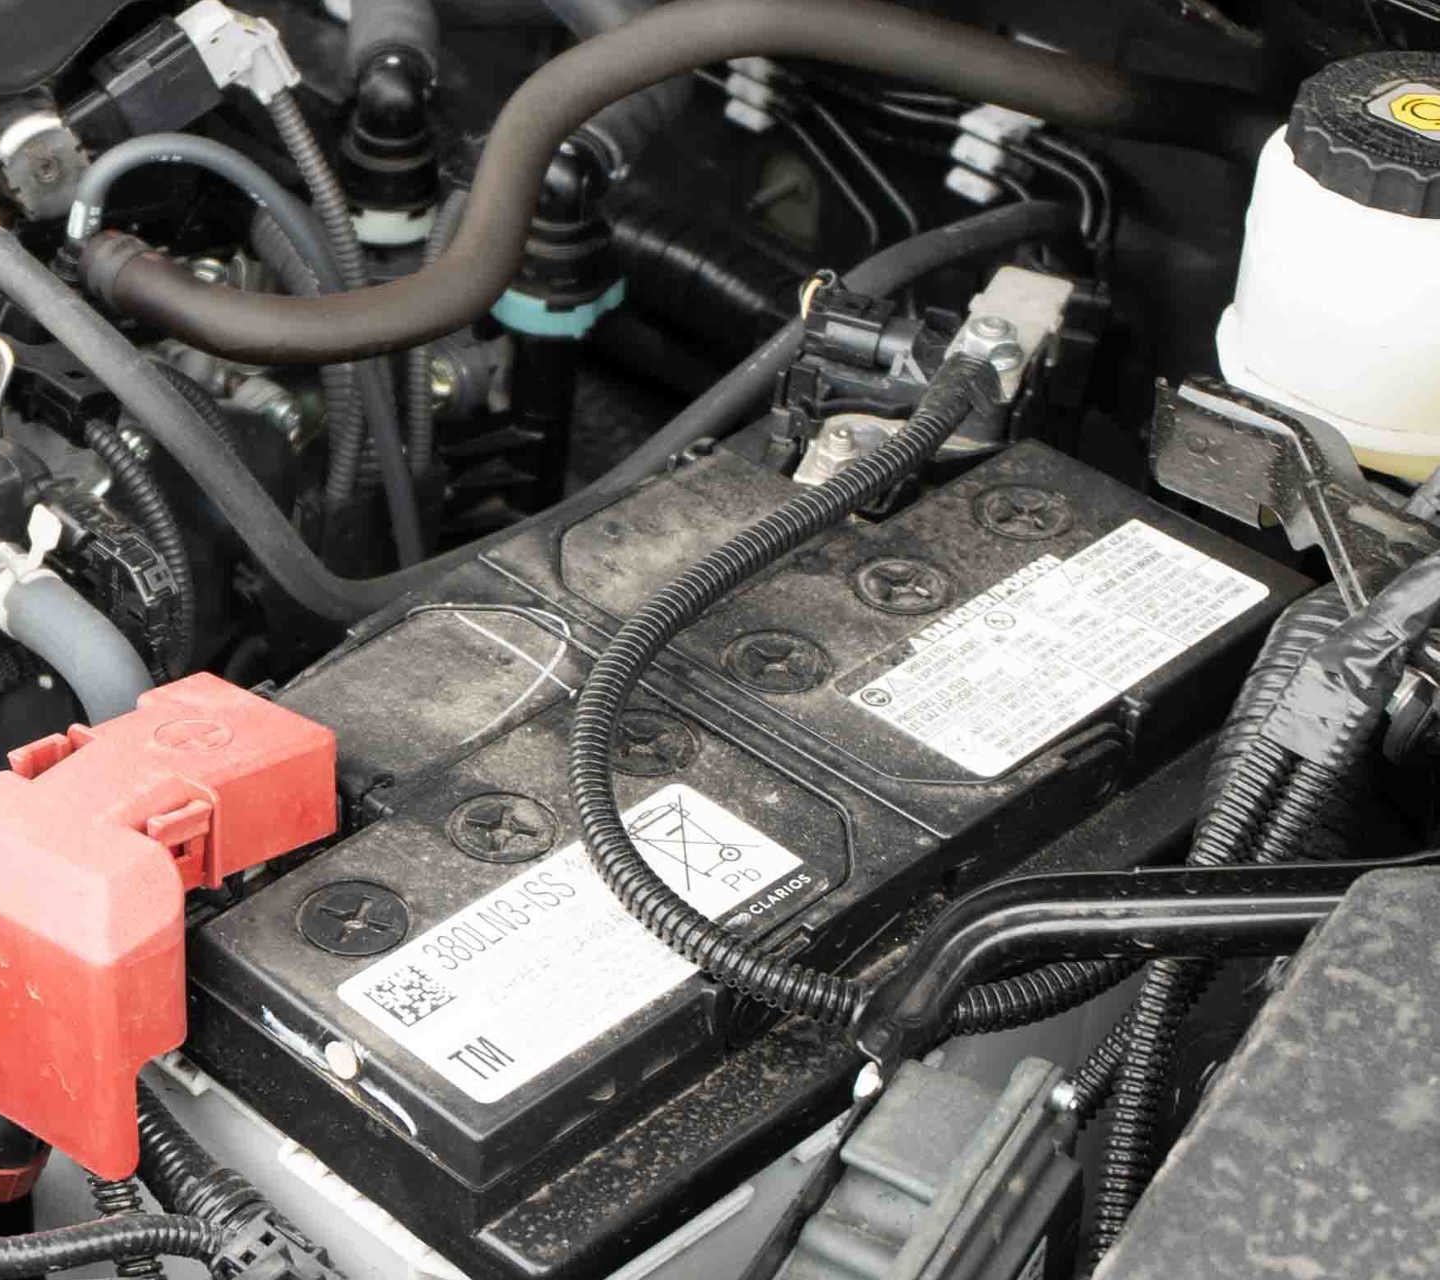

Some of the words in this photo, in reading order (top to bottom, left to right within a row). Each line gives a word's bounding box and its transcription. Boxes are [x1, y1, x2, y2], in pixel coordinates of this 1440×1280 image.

[922, 553, 1065, 646] DANGER/POISON
[721, 867, 762, 892] Pb
[749, 872, 811, 916] CLARIOS
[423, 871, 577, 971] 380LN3-ISS
[447, 1036, 516, 1080] TM
